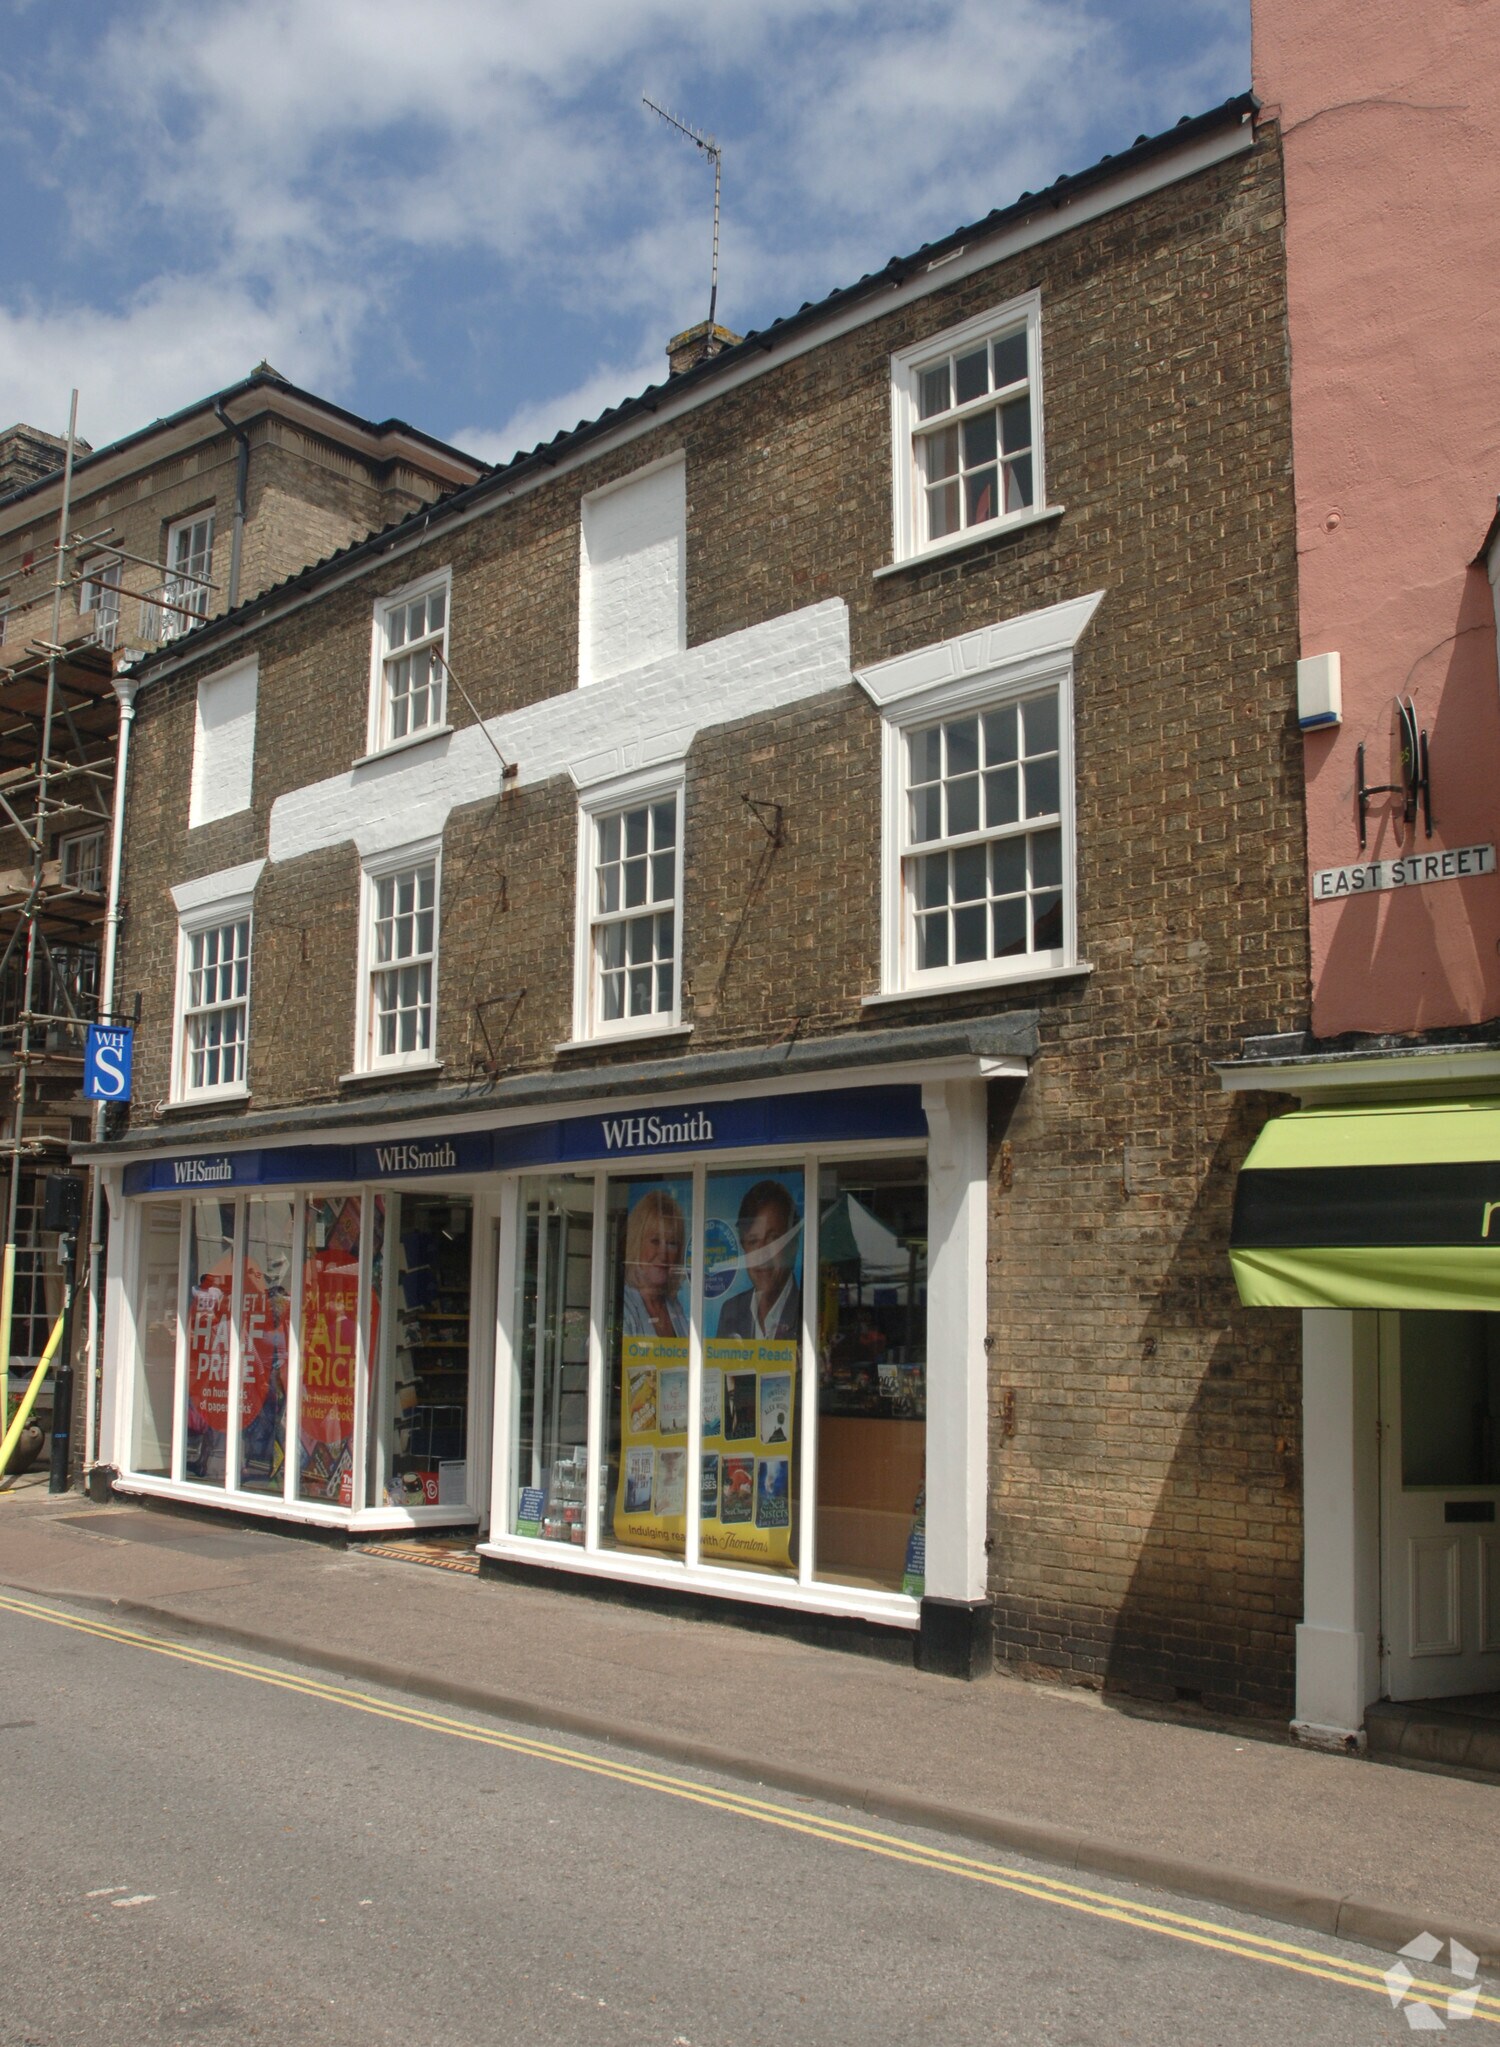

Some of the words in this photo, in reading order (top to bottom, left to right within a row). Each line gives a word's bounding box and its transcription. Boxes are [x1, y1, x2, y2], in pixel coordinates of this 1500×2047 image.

[1321, 865, 1381, 895] EAST
[1392, 847, 1488, 884] STREET
[95, 1031, 125, 1048] WH
[93, 1046, 125, 1096] S
[601, 1110, 714, 1150] WHSmith
[173, 1158, 232, 1184] WHSmith
[375, 1143, 457, 1172] WHSmith
[628, 1343, 650, 1357] Our
[653, 1343, 688, 1358] choice
[706, 1346, 754, 1361] Summer
[758, 1347, 793, 1362] Reads
[628, 1524, 670, 1542] Indulging
[719, 1531, 769, 1553] Thorntons
